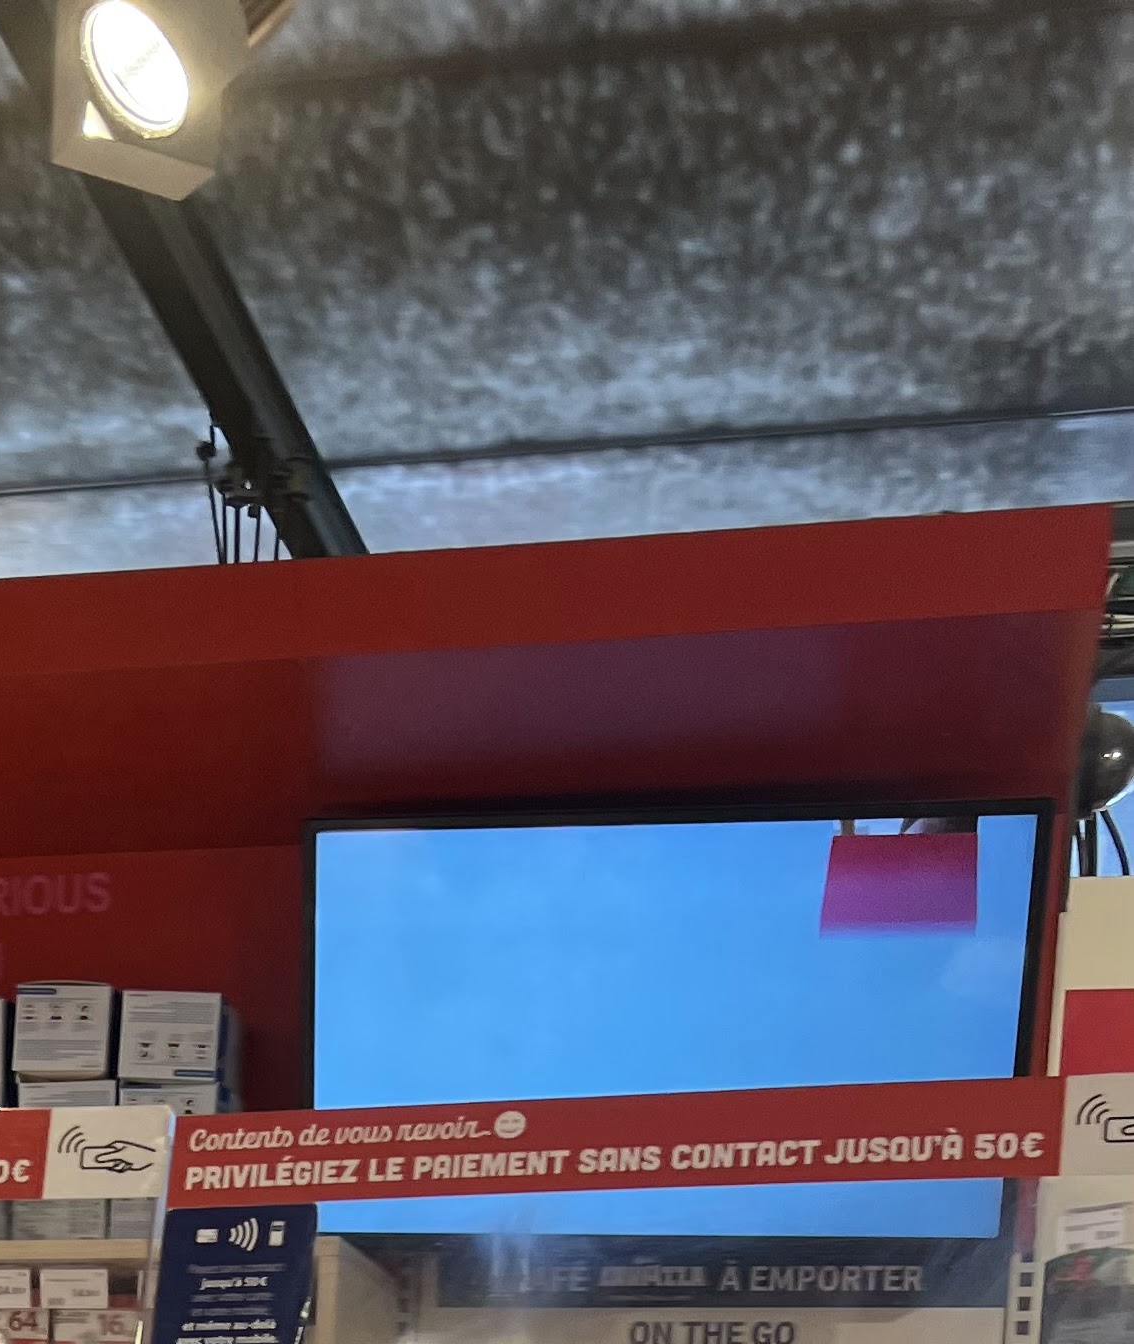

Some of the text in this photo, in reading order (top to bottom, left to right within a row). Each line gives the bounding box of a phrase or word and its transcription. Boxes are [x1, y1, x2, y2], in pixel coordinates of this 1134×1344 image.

[189, 1124, 295, 1154] Contents
[298, 1122, 331, 1147] de
[334, 1124, 394, 1145] vous
[184, 1127, 1045, 1191] PRIVILÉGIEZ LE PAIEMENT SANS CONTACT JUSQU'À 50€
[749, 1264, 924, 1293] EMPORTER
[9, 1311, 38, 1331] 64
